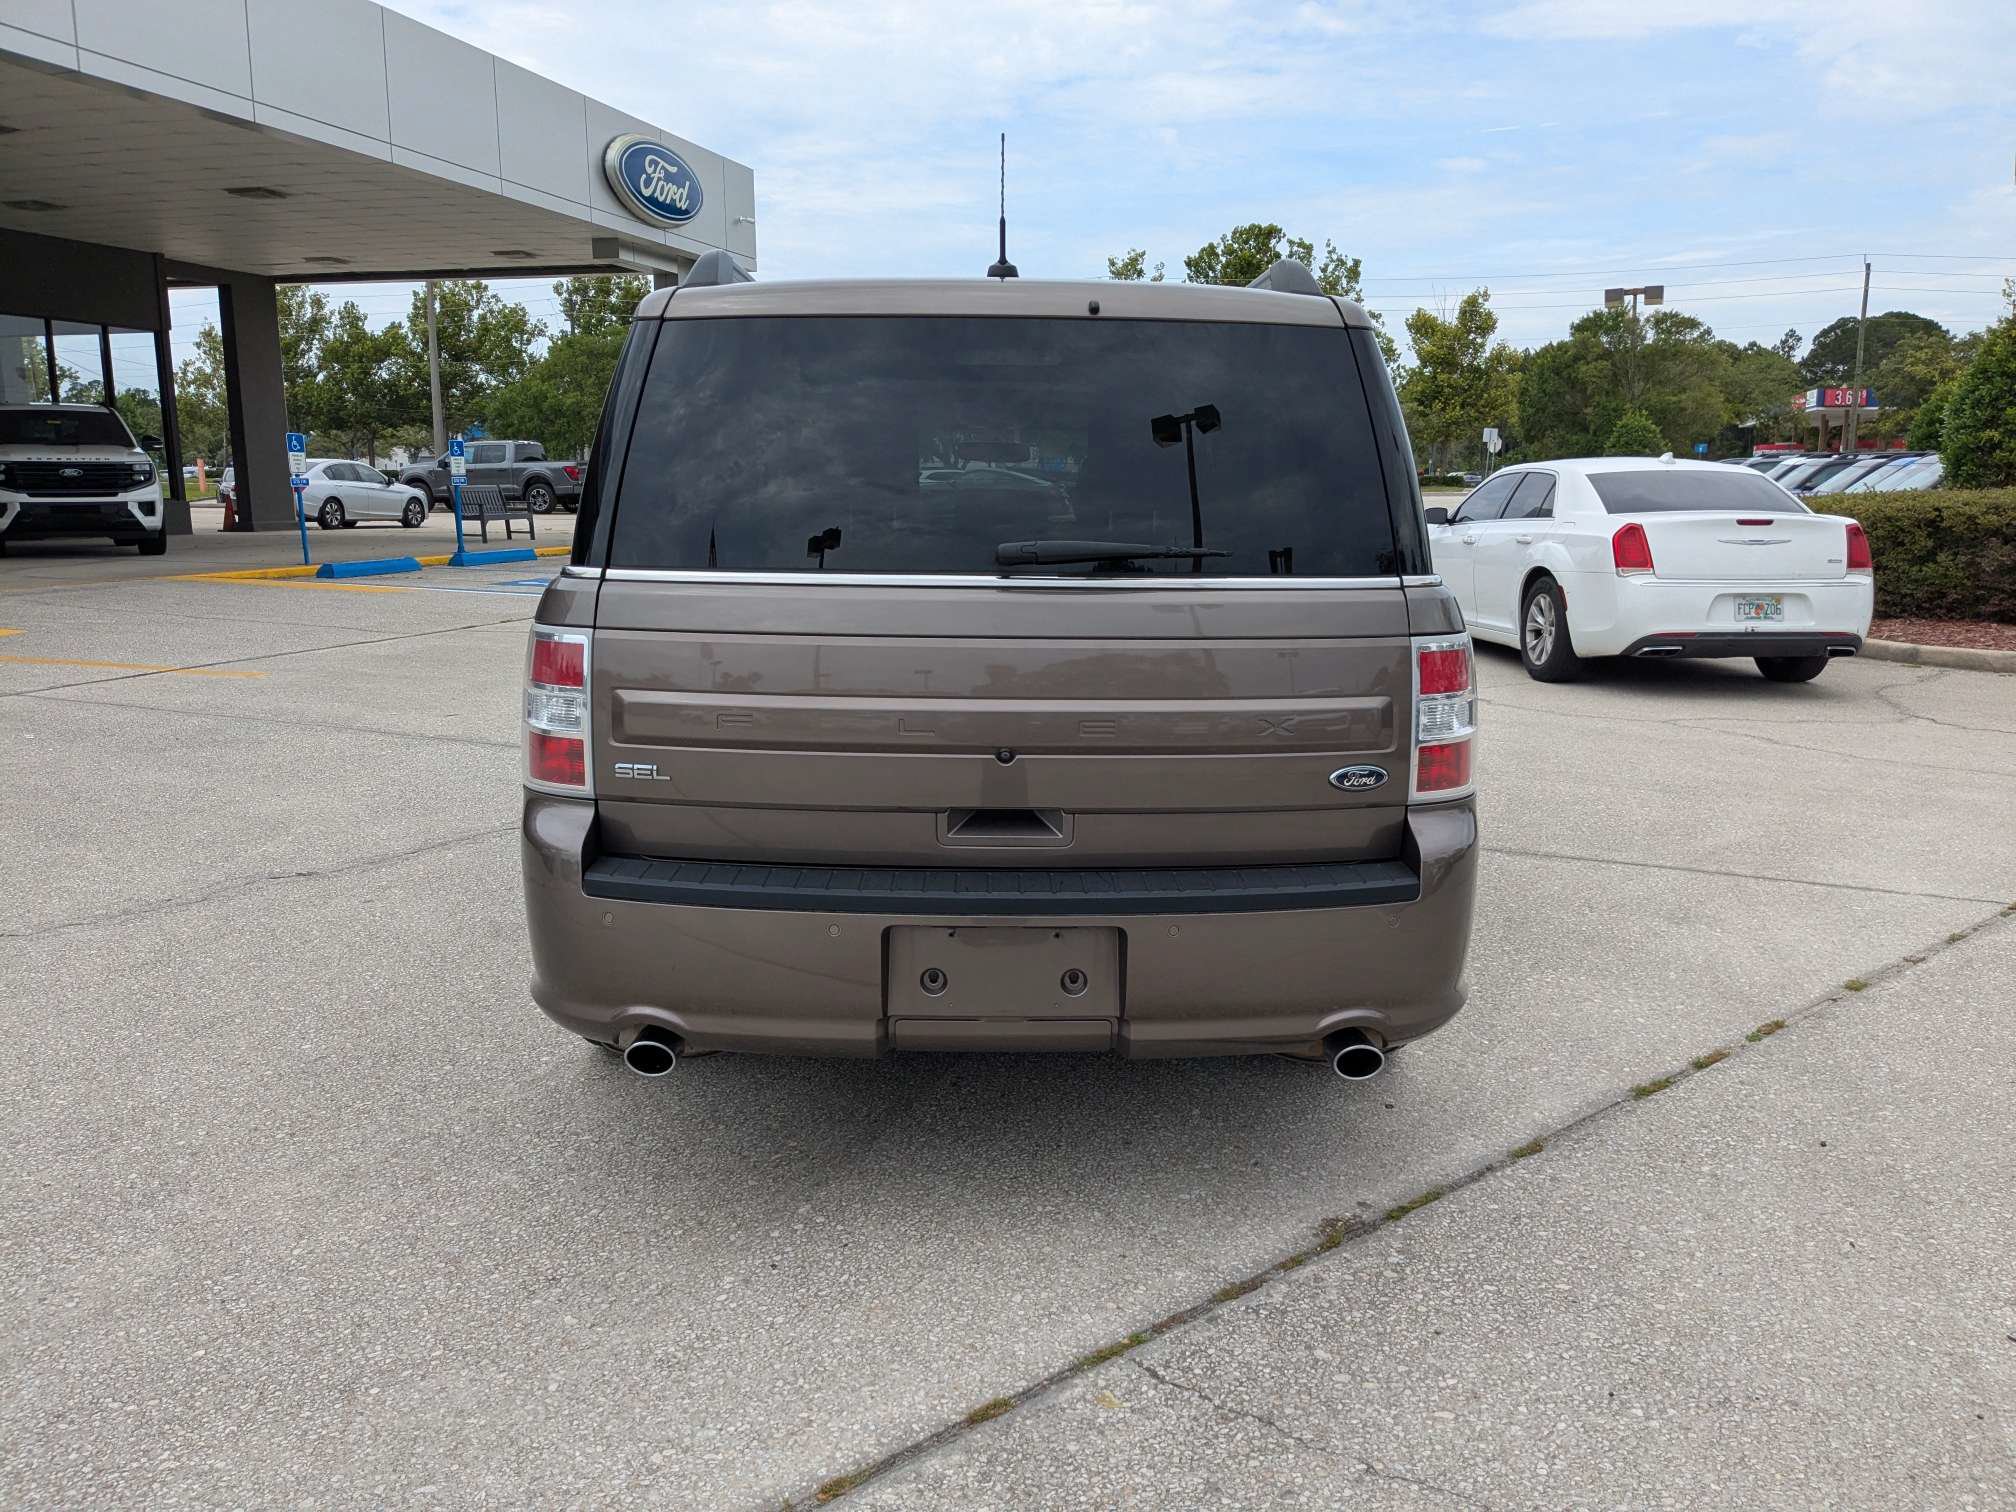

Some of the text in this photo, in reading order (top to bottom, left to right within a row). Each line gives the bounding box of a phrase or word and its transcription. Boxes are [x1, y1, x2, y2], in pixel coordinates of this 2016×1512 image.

[640, 154, 690, 210] Ford
[715, 713, 1298, 738] FLEX
[615, 763, 671, 780] SEL
[1344, 769, 1377, 786] Ford
